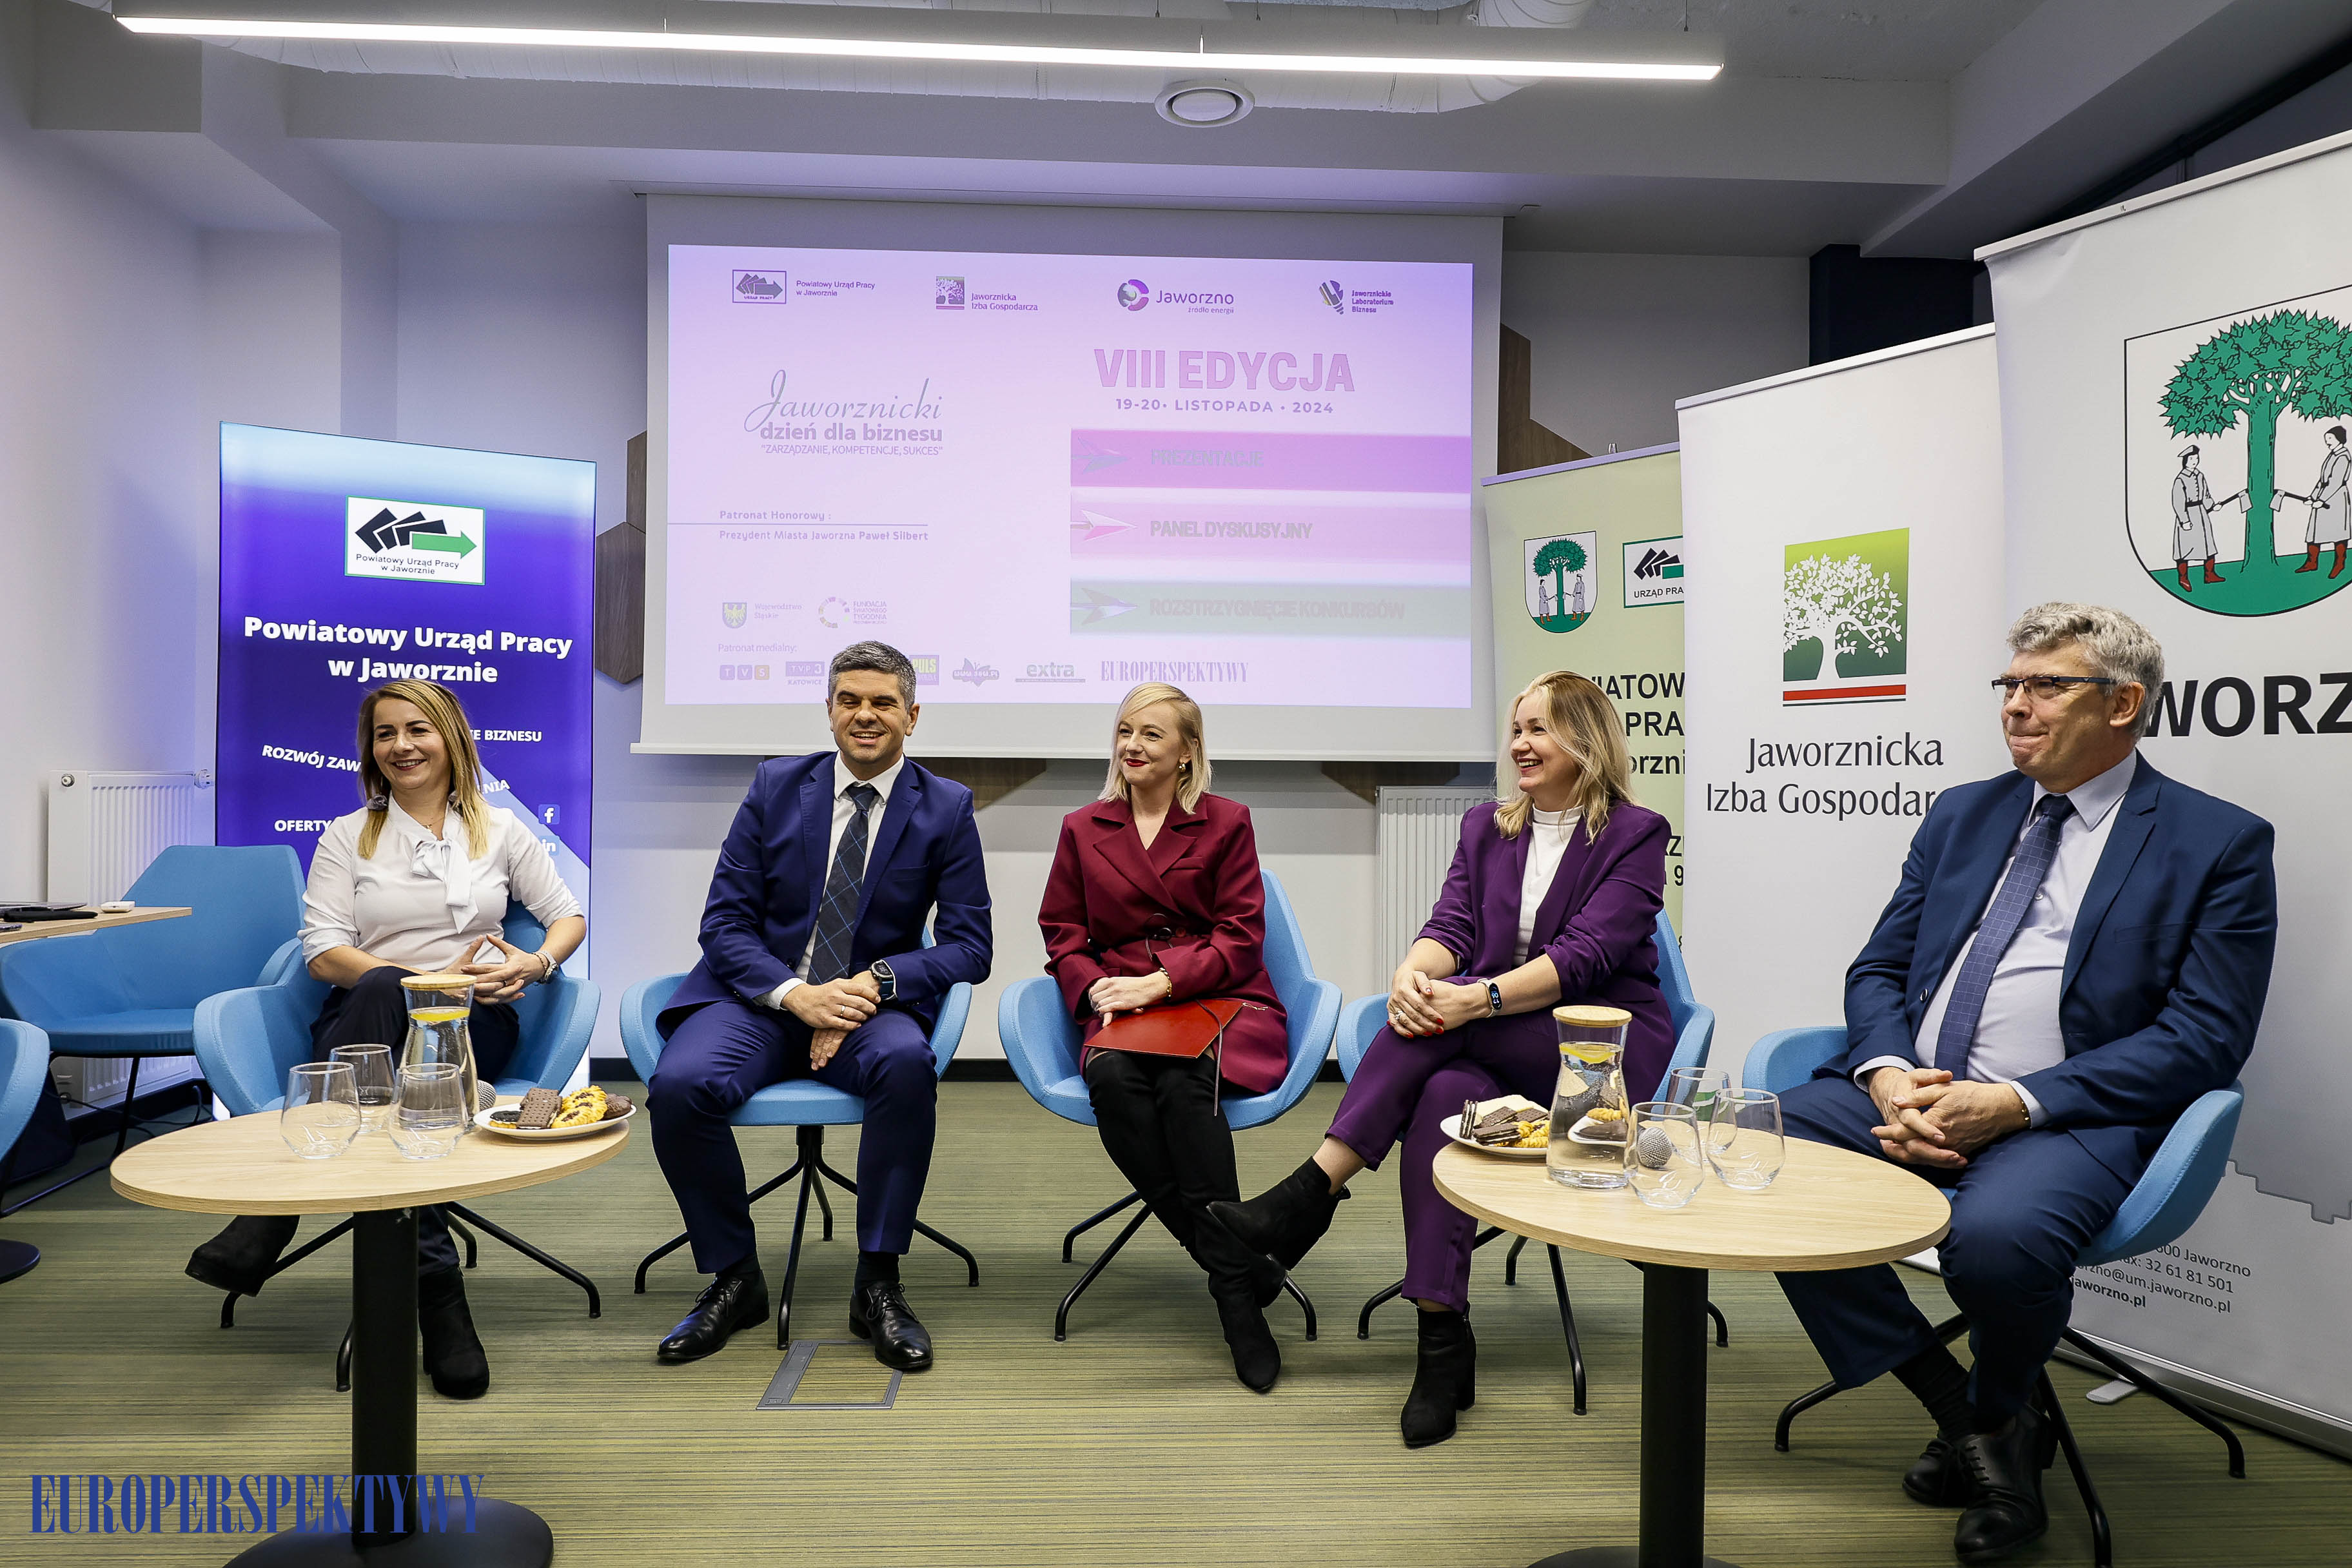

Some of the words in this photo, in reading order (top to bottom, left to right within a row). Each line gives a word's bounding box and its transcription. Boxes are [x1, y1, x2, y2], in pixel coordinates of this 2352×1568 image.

[796, 280, 832, 289] Powiatowy
[834, 281, 854, 289] Urząd
[972, 293, 1017, 301] Jaworznicka
[1156, 290, 1234, 304] Jaworzno
[990, 302, 1038, 311] Gospodarcza
[1093, 349, 1165, 388] VIII
[1179, 350, 1355, 391] EDYCJA
[744, 369, 943, 432] Jaworznicki
[1175, 400, 1273, 413] LISTOPADA
[1293, 402, 1334, 413] 2024
[760, 422, 816, 440] dzień
[824, 422, 856, 441] dla
[863, 423, 943, 442] biznesu
[1151, 449, 1264, 467] PREZENTACJE
[720, 511, 767, 520] Patronat
[771, 511, 825, 522] Honorowy
[720, 531, 770, 541] Prezydent
[774, 531, 808, 540] Miasta
[811, 531, 856, 540] Jaworzna
[859, 531, 890, 540] Paweł
[893, 531, 928, 540] Silbert
[1150, 520, 1202, 537] PANEL
[1204, 521, 1313, 539] DYSKUSYJNY
[356, 554, 404, 565] Powiatowy
[407, 558, 432, 567] Urząd
[435, 560, 459, 569] Pracy
[391, 565, 435, 574] Jaworznie
[1634, 588, 1663, 598] URZĄD
[1665, 586, 1684, 595] PRA
[244, 617, 407, 651] Powiatowy
[415, 627, 492, 655] Urząd
[500, 632, 573, 660] Pracy
[718, 643, 754, 652] Patronat
[756, 643, 797, 654] medialny:
[328, 659, 354, 676] w
[358, 658, 498, 682] Jaworznie
[912, 659, 937, 674] PULS
[1026, 662, 1074, 677] extra
[1101, 661, 1248, 682] EUROPERSPEKTYWY
[1592, 672, 1685, 700] ATOW
[1625, 710, 1685, 737] PRA
[484, 730, 542, 741] BIZNESU
[262, 745, 325, 769] ROZWÓJ
[1745, 732, 1944, 774] Jaworznicka
[478, 779, 510, 795] NIA
[1707, 781, 1767, 812] Izba
[274, 819, 332, 832] OFERTY
[2183, 1249, 2251, 1277] Jaworzno
[2145, 1258, 2162, 1273] 32
[2166, 1264, 2182, 1279] 61
[2186, 1269, 2203, 1284] 81
[2208, 1275, 2234, 1293] 501
